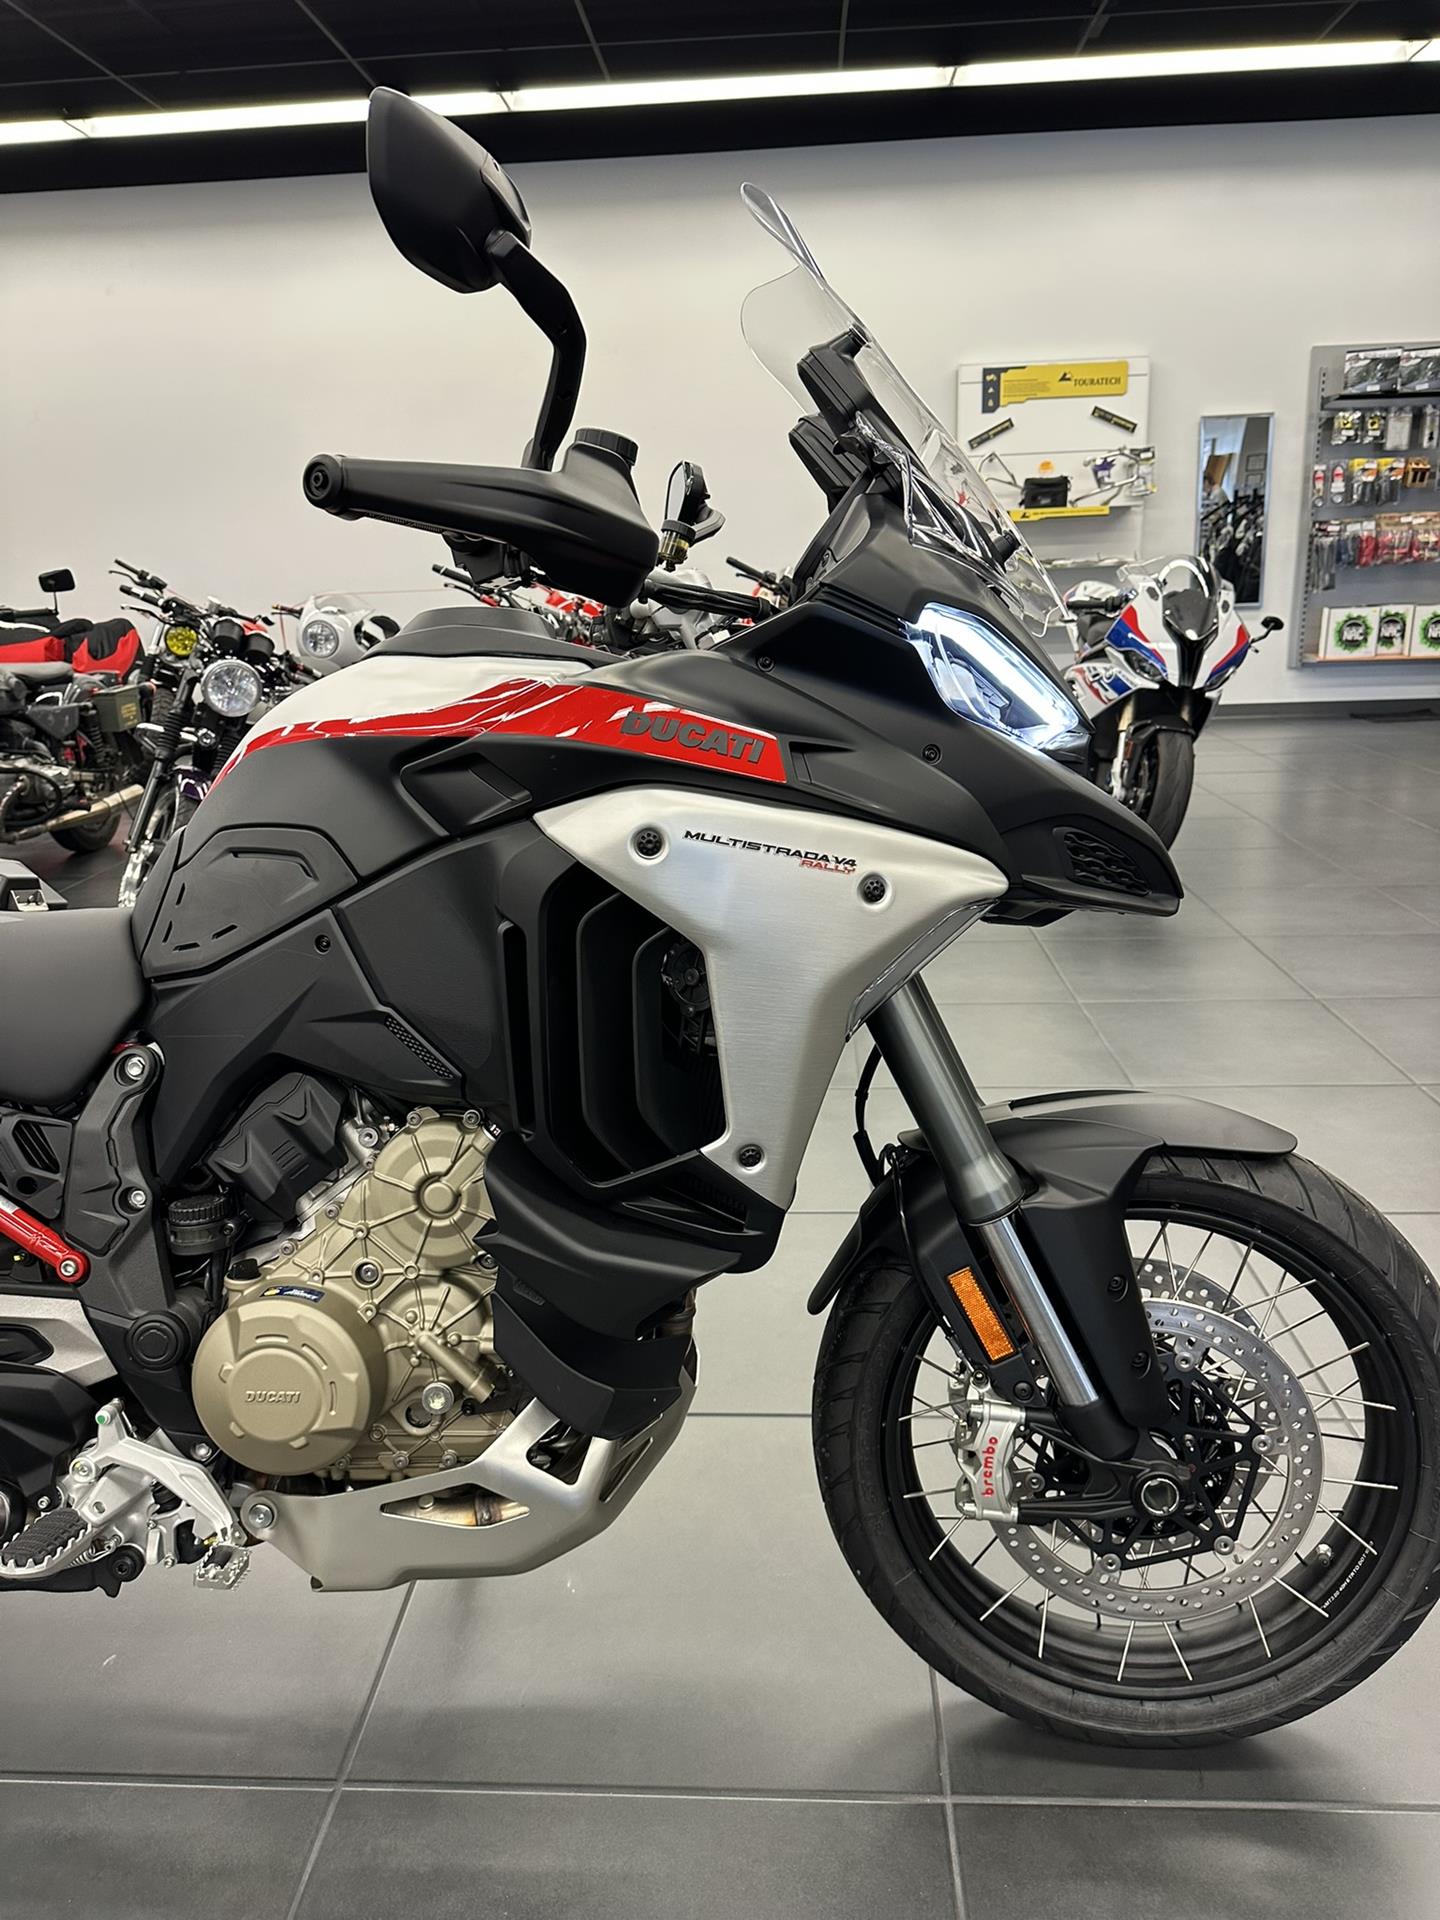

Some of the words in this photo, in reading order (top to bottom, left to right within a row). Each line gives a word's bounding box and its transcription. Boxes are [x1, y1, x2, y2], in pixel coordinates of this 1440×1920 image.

[1073, 376, 1121, 387] TOURATECH
[620, 711, 766, 764] DUCATI
[684, 830, 831, 863] MULTISTRADA
[832, 855, 857, 867] V4
[800, 859, 856, 875] RALLY
[245, 1390, 301, 1404] DUCATI
[981, 1436, 998, 1496] brembo
